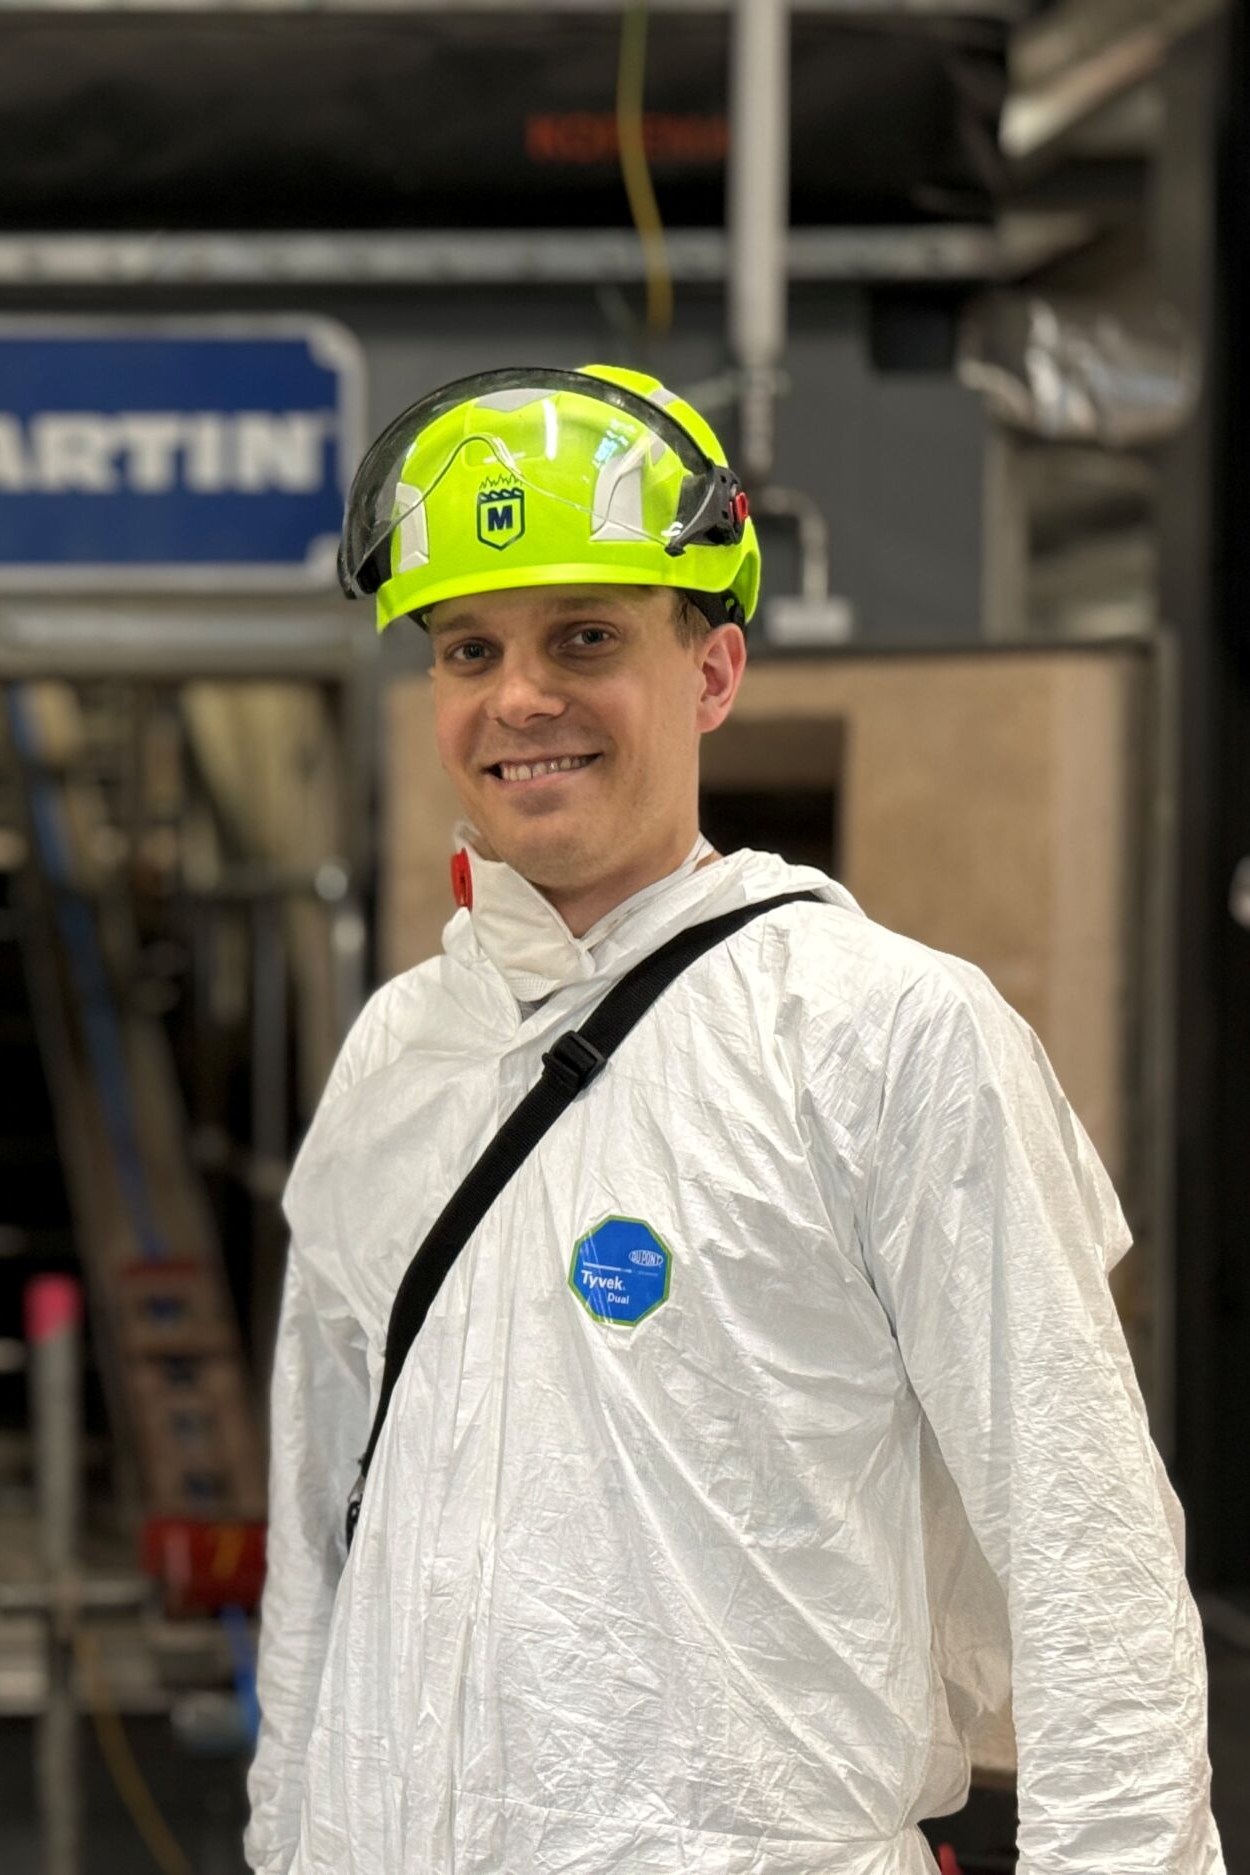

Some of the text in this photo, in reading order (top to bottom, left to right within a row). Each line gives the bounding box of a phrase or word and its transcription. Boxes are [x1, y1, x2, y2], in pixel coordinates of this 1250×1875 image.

[487, 504, 513, 532] M
[581, 1269, 623, 1291] Tyvek
[607, 1292, 630, 1305] Dual
